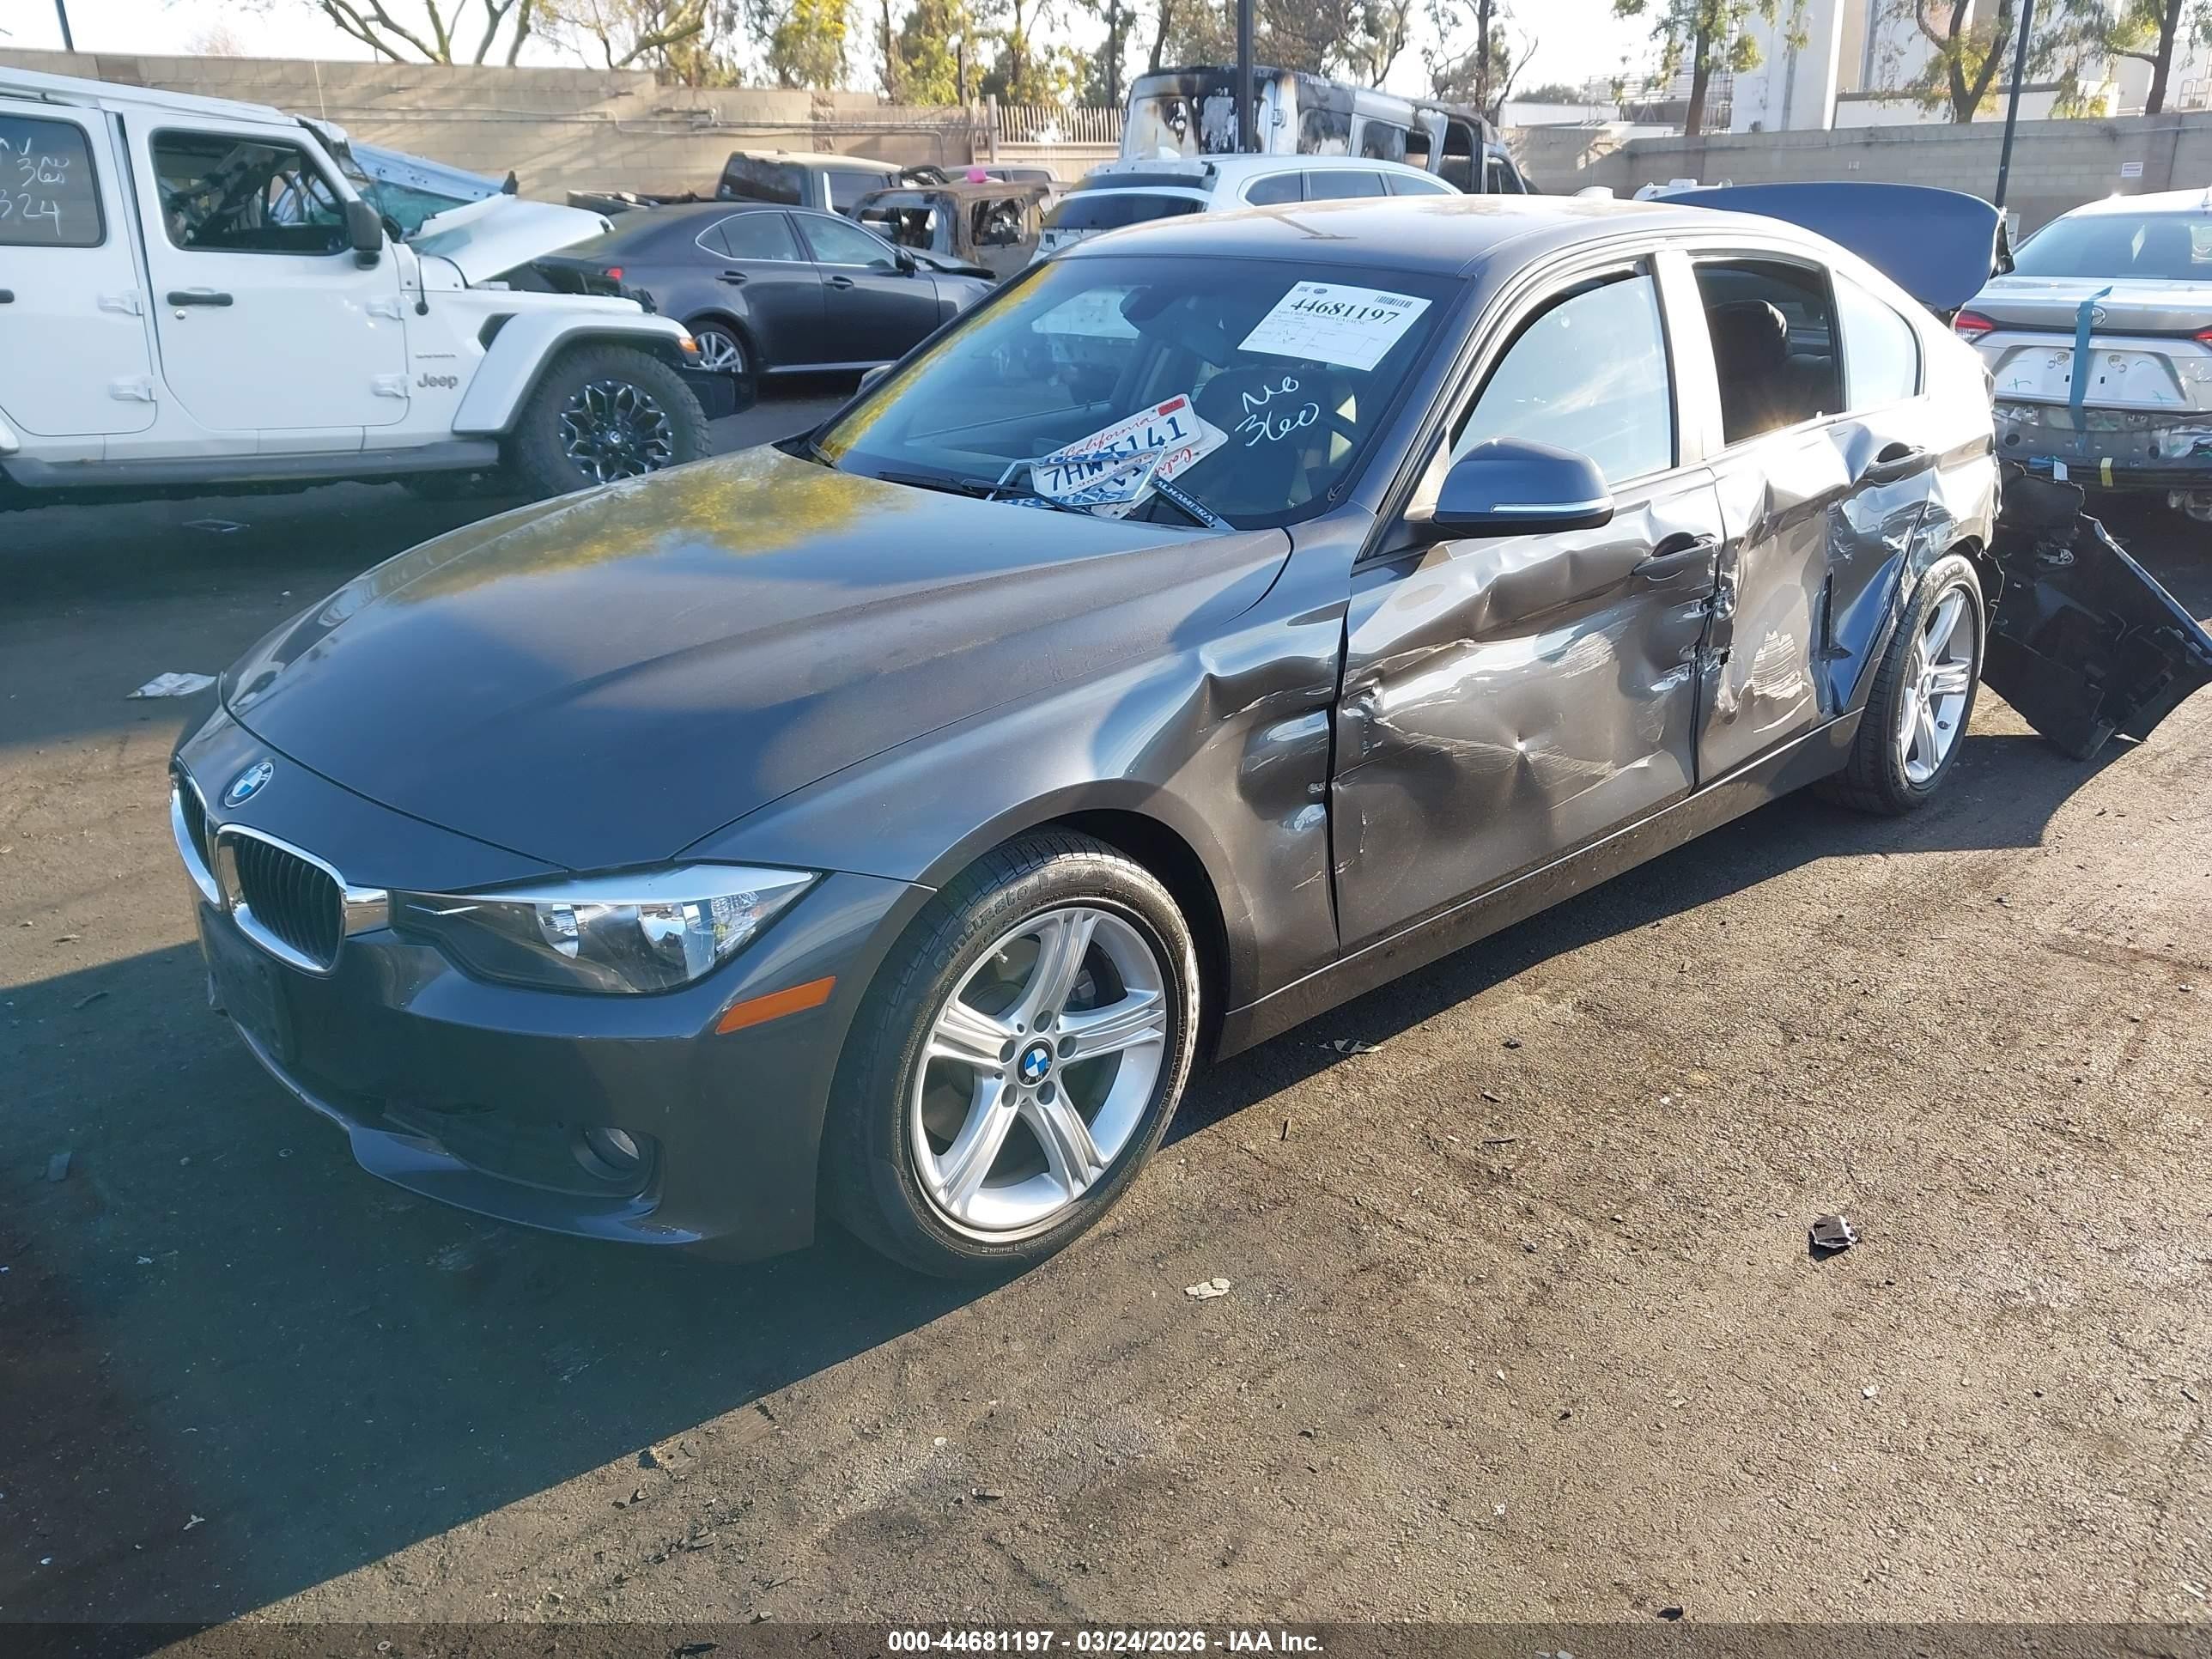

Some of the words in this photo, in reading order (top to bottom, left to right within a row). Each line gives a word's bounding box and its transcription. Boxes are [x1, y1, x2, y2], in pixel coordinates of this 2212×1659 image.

[1290, 298, 1401, 325] 44681197
[416, 373, 458, 389] Jeep
[1242, 376, 1299, 415] No
[1064, 414, 1159, 457] California
[1234, 402, 1320, 447] 360
[1043, 416, 1188, 492] 7HWT141
[1153, 479, 1215, 524] ALHAMBRA
